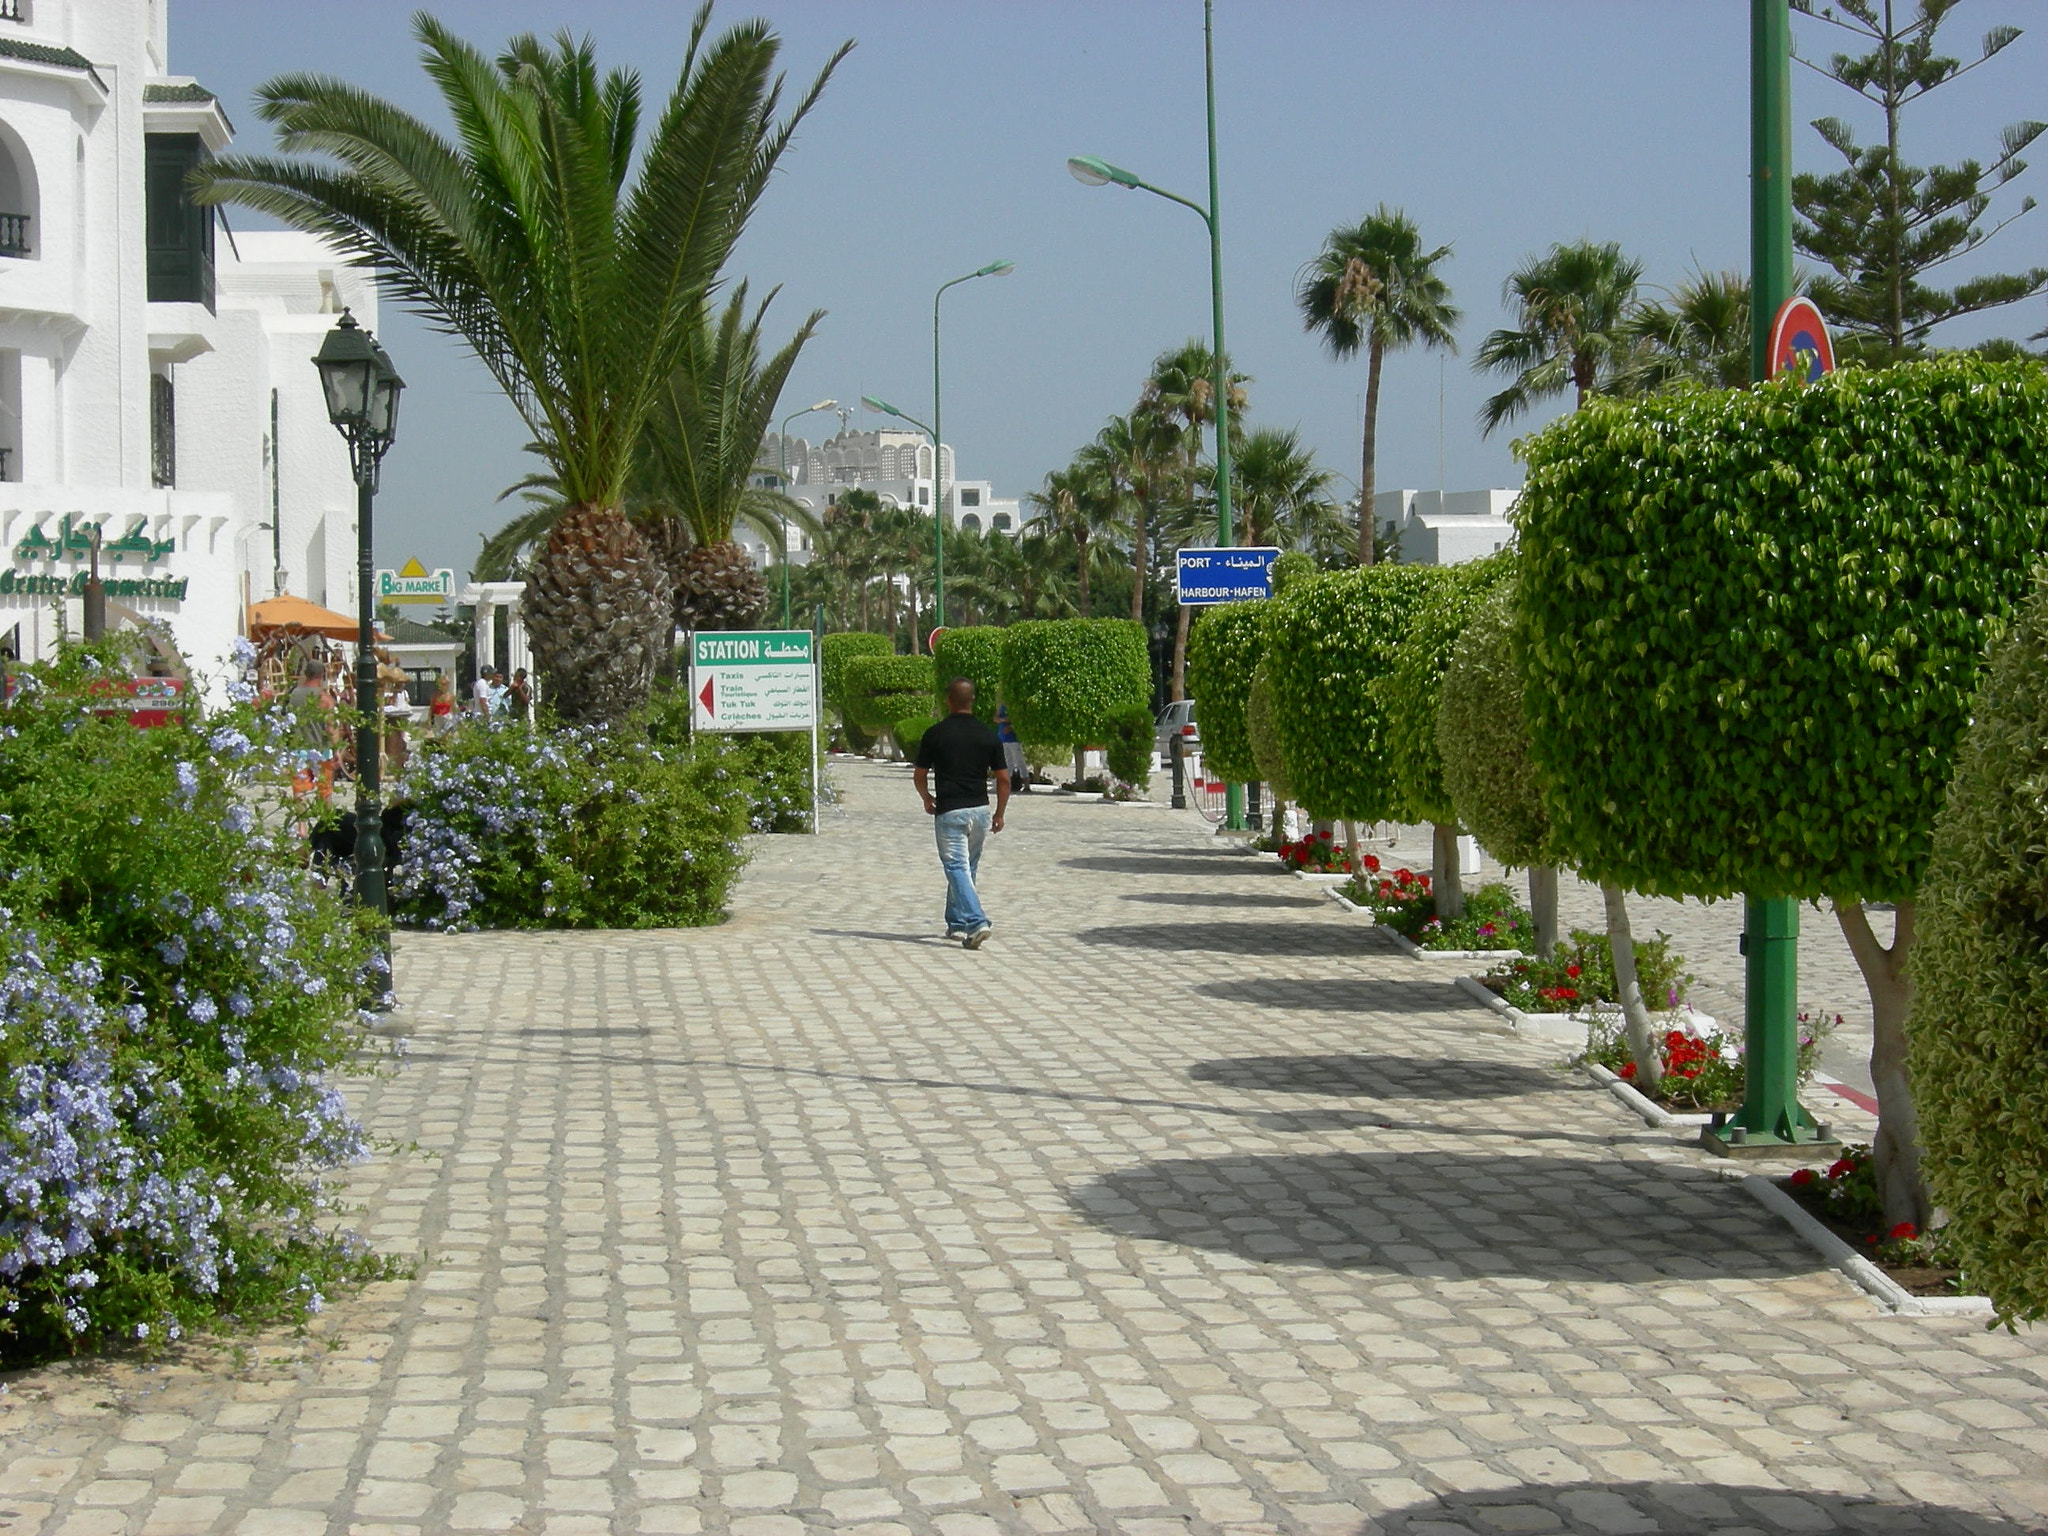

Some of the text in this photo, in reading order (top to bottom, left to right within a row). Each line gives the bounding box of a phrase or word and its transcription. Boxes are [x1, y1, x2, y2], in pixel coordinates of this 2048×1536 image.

[101, 515, 175, 562] مركب
[1180, 557, 1211, 568] PORT
[1225, 555, 1265, 570] الميناء
[71, 570, 189, 601] Cmmercial
[405, 571, 450, 593] MARKET
[698, 640, 760, 660] STATION
[764, 640, 809, 659] محطة
[740, 700, 756, 708] Tuk
